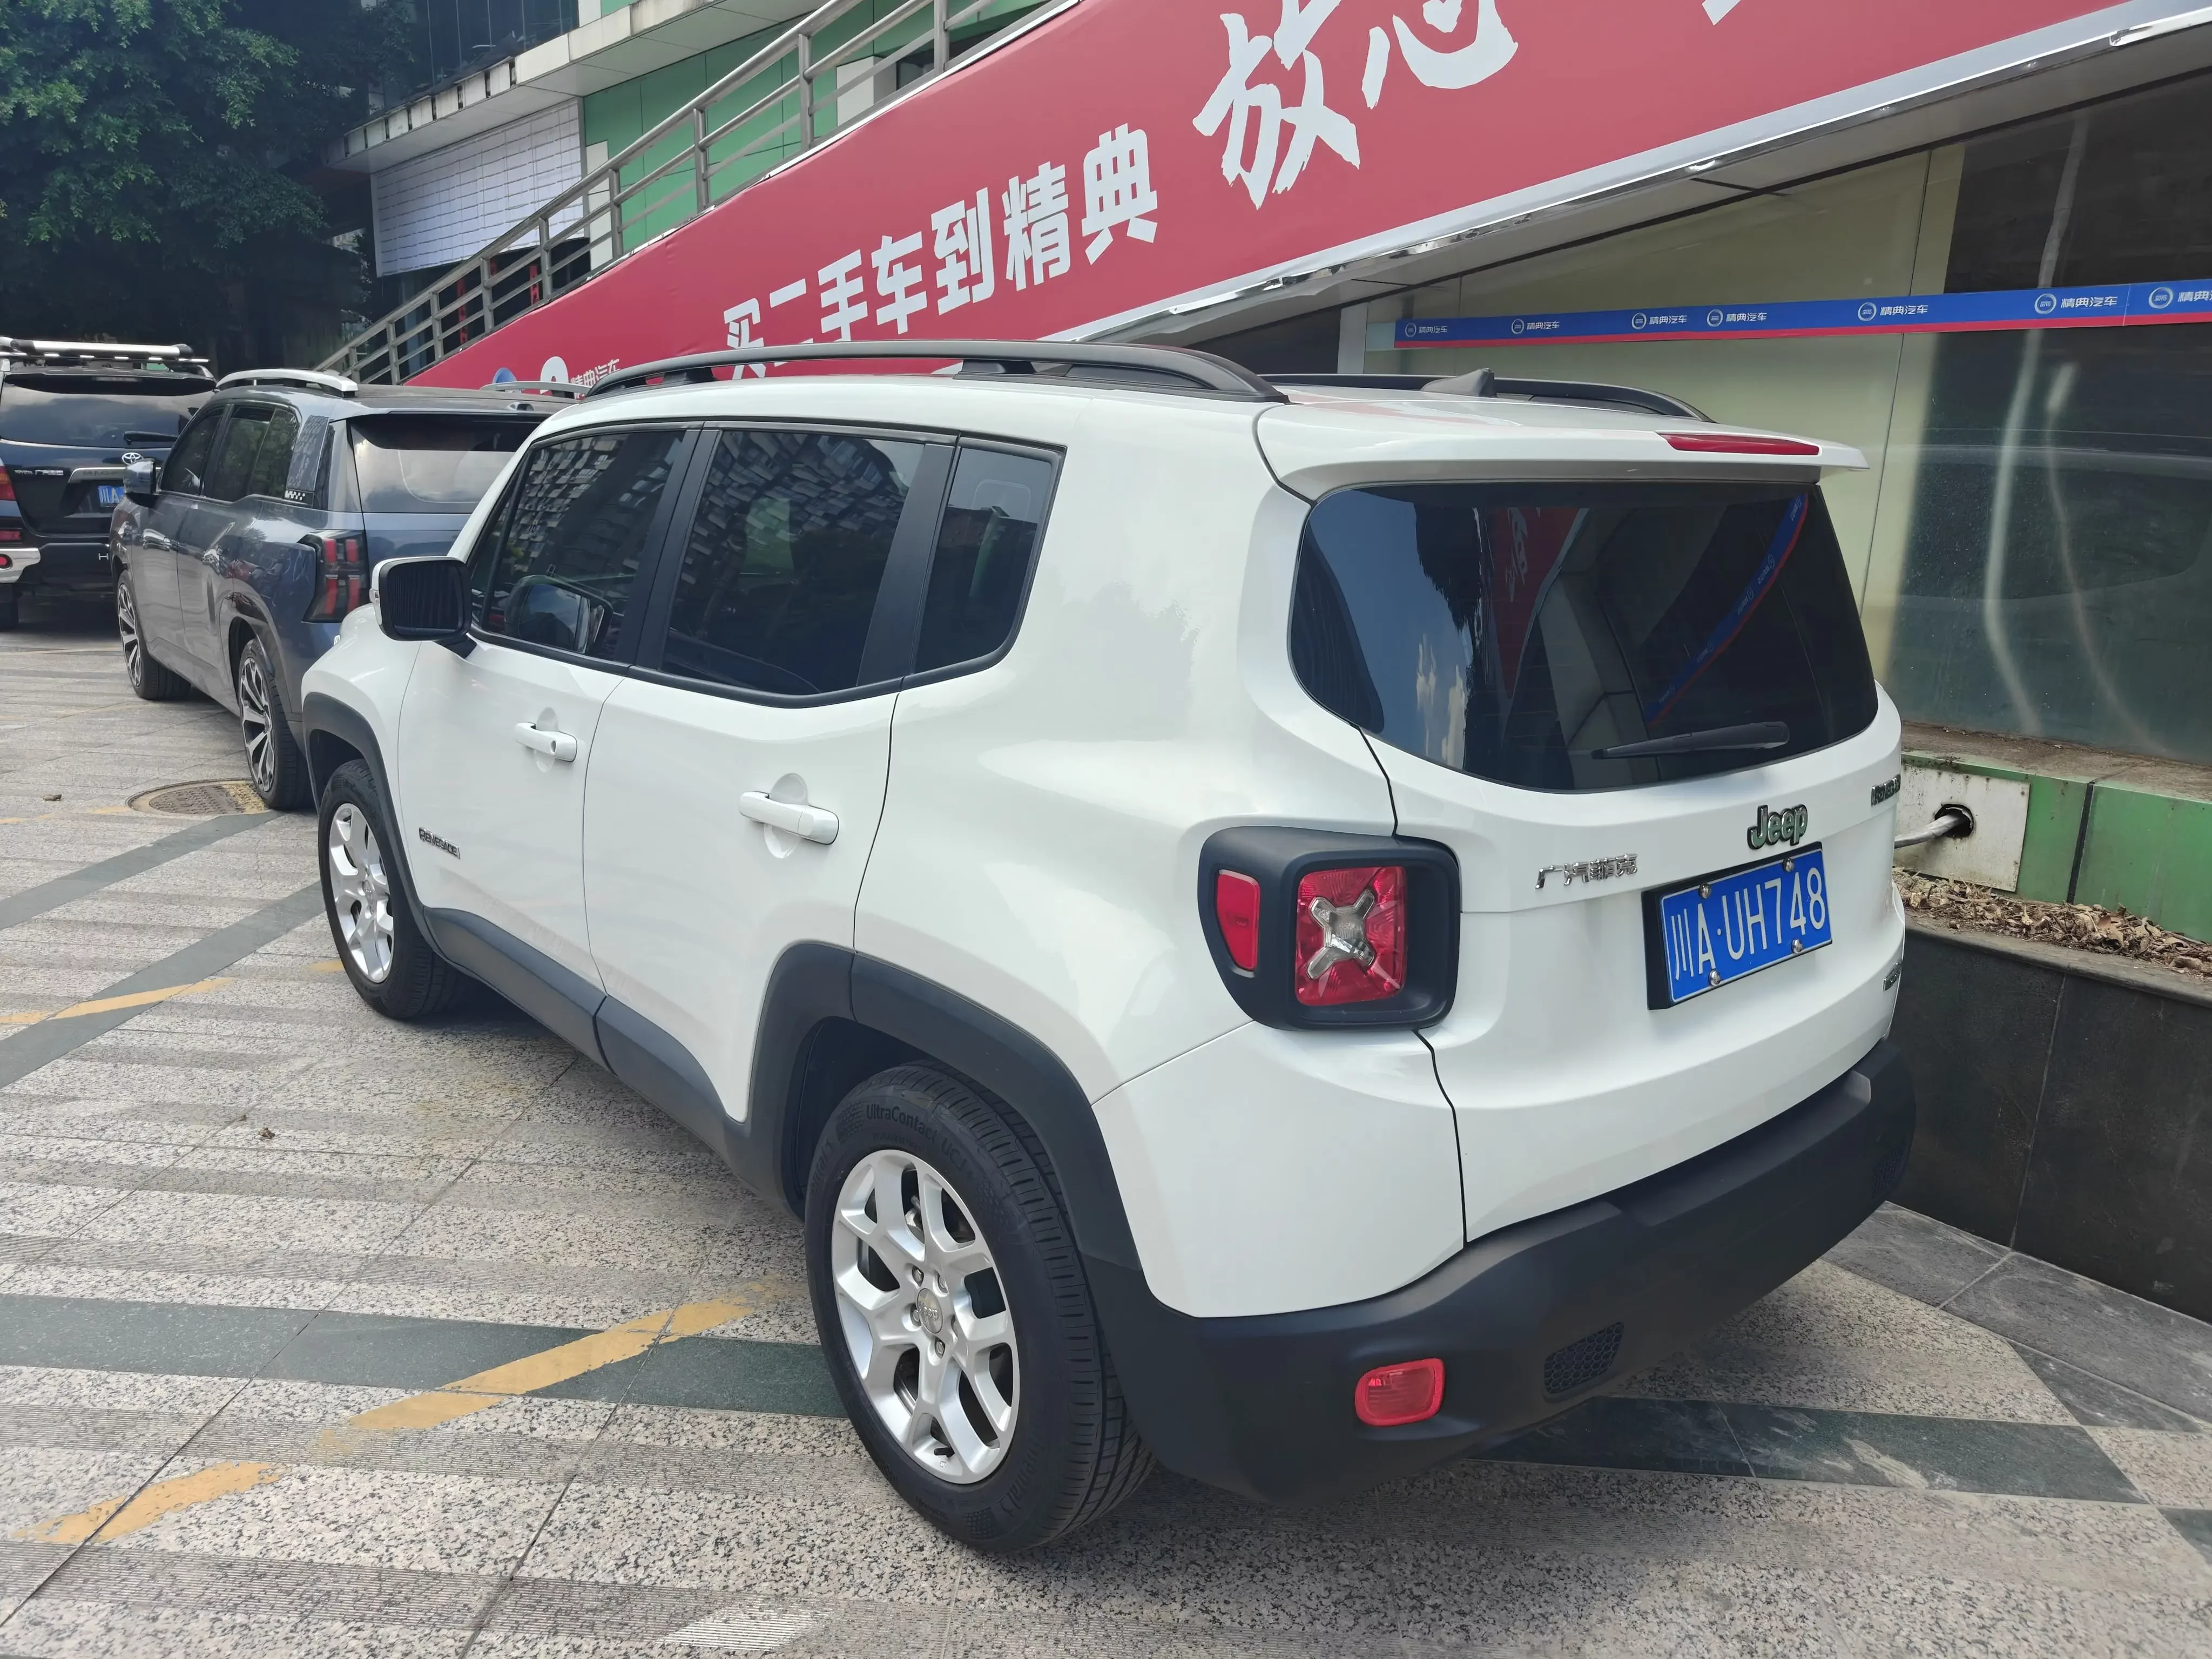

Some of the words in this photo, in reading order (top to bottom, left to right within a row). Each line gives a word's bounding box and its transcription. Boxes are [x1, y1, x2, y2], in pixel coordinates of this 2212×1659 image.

[724, 123, 1158, 380] 买二手车到精典
[1879, 304, 1928, 316] 精典汽车
[2060, 295, 2118, 308] 精典汽车
[1526, 321, 1560, 331] 精典汽车
[1649, 314, 1688, 325] 精典汽车
[1725, 312, 1768, 322] 精典汽车
[1746, 804, 1808, 850] Jeep
[419, 827, 461, 860] RENEGADE
[1534, 853, 1638, 889] 广汽菲克
[866, 1103, 939, 1144] UltraContact
